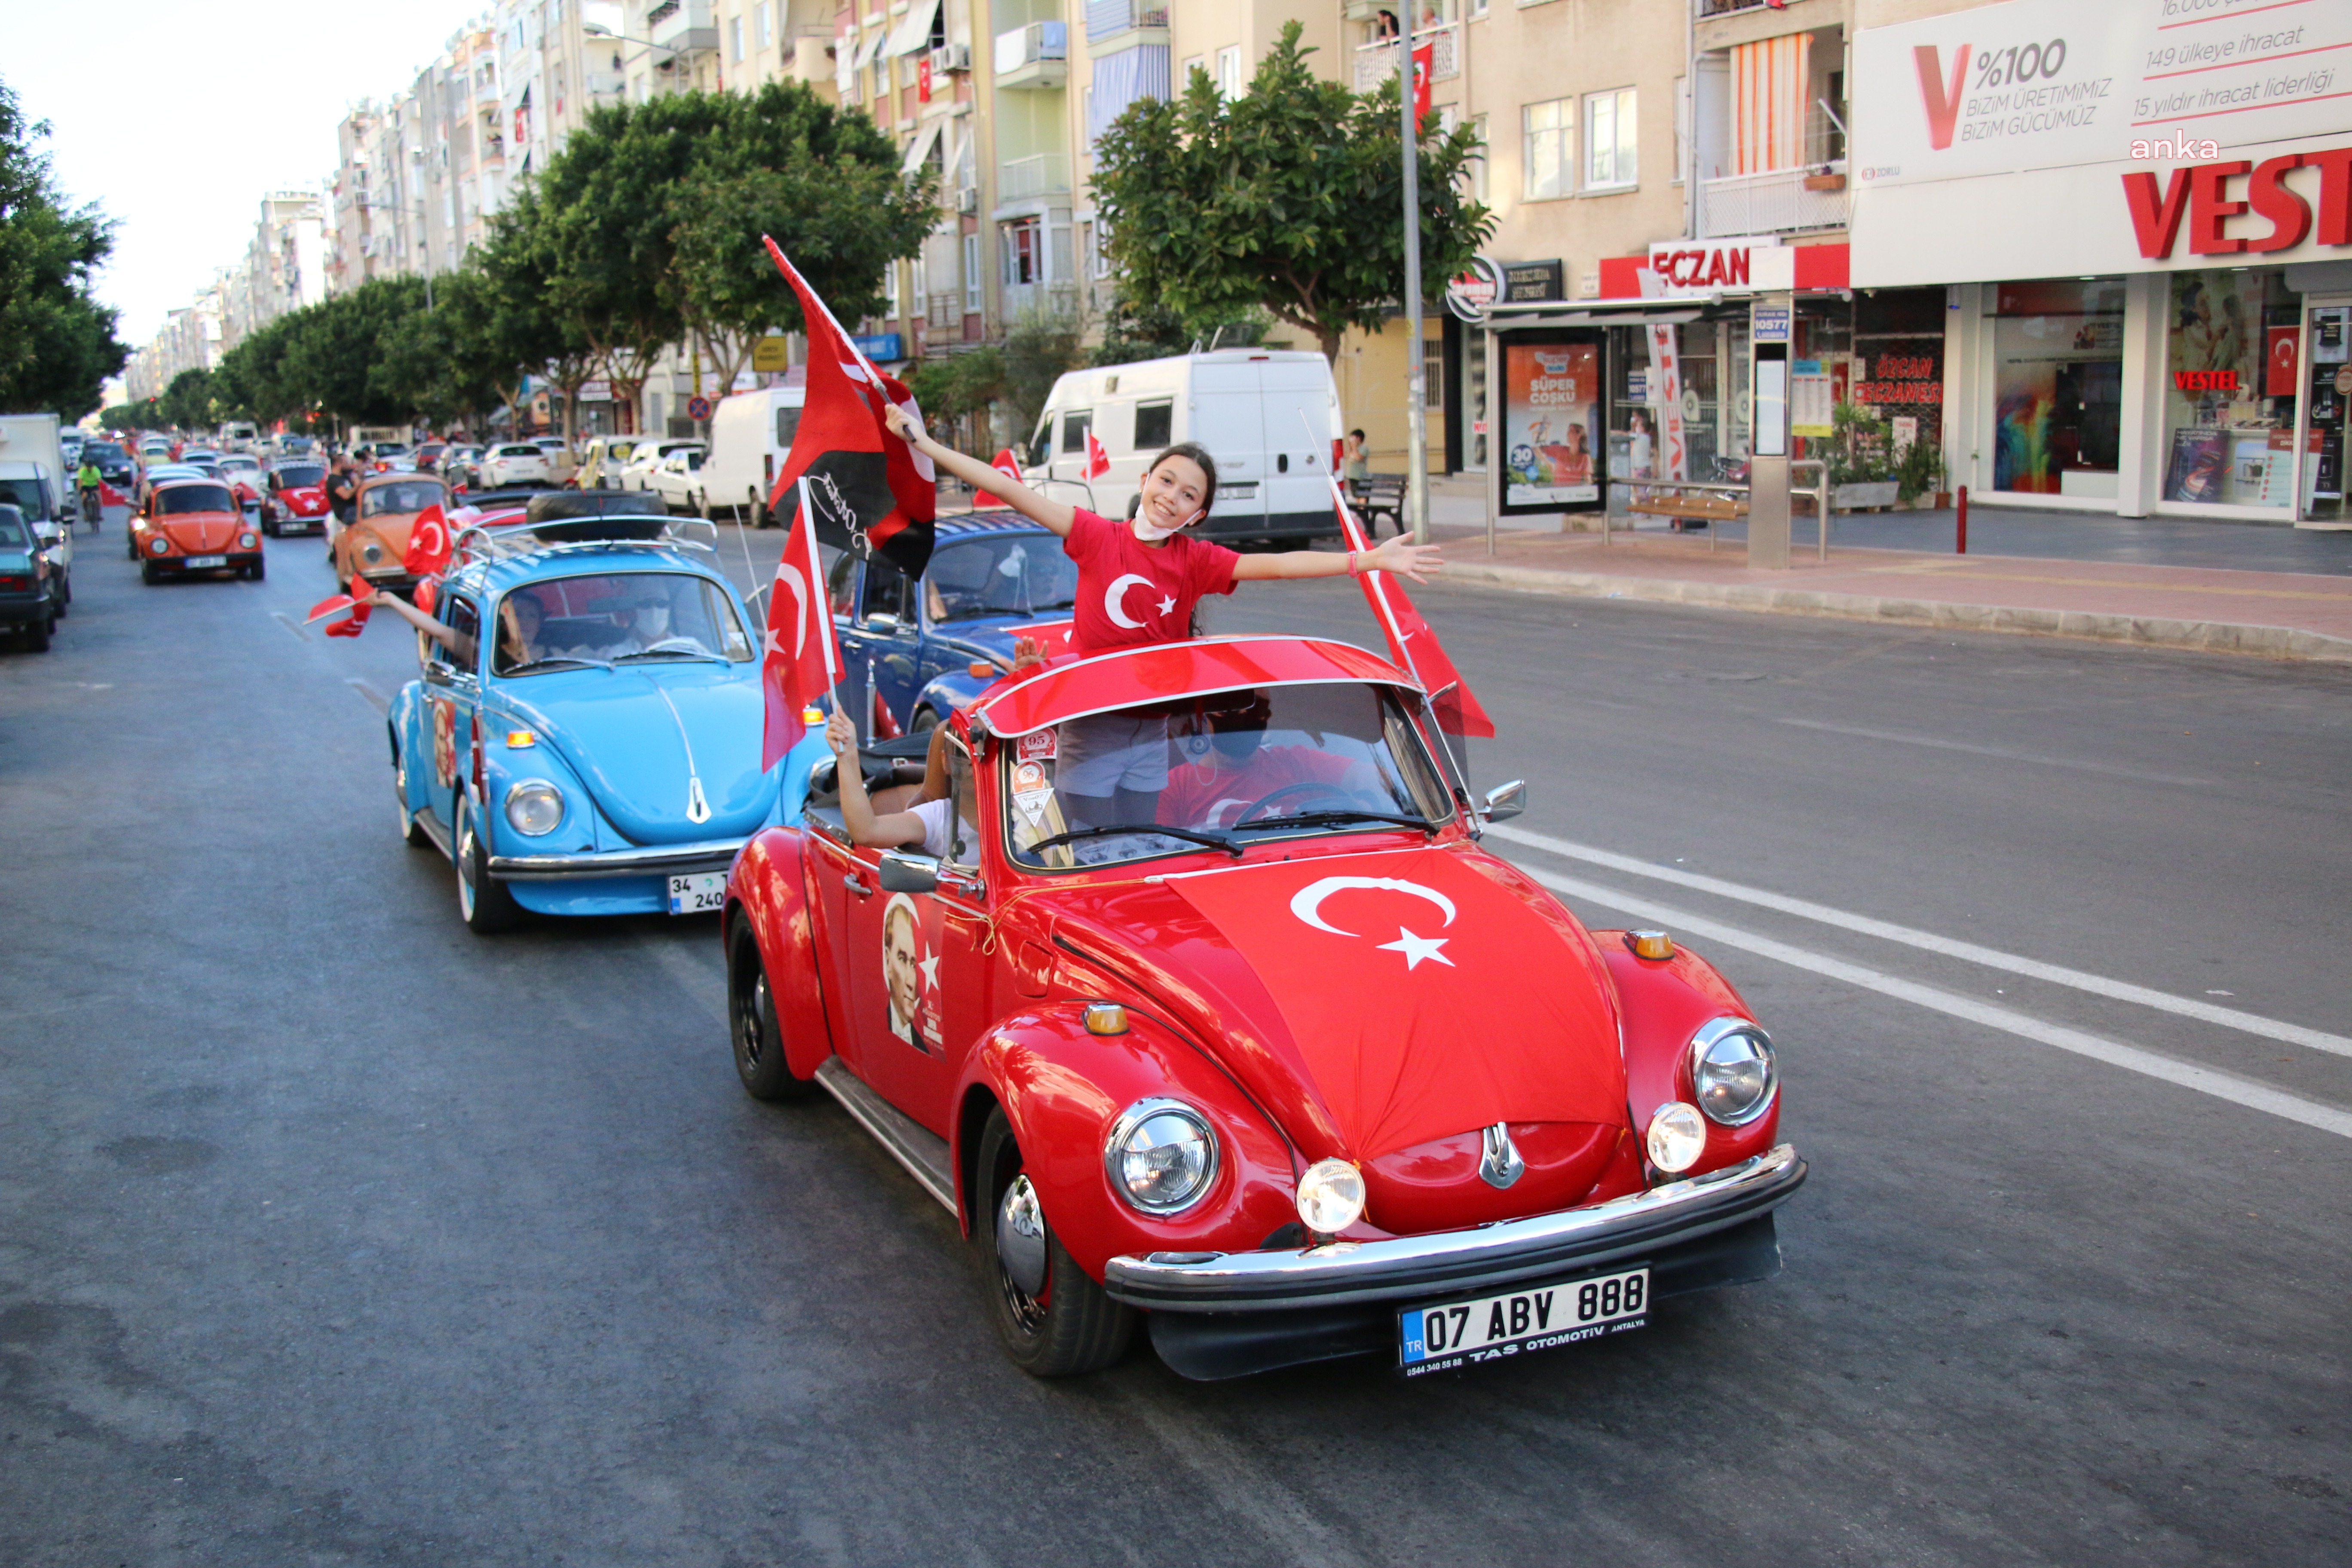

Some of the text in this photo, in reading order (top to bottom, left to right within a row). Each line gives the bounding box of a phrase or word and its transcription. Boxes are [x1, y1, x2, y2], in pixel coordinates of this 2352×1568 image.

[2147, 25, 2304, 69] 149 ülkeye ihracat
[1975, 38, 2066, 89] %100
[2134, 68, 2336, 118] 15 yıldır ihracat liderliği
[2008, 105, 2097, 135] GÜCÜMÜZ
[2121, 147, 2352, 259] VEST
[1755, 319, 1788, 330] 10577
[1876, 354, 1934, 378] ÖZCAN
[1530, 375, 1575, 392] SÜPER
[2173, 370, 2243, 390] VESTEL
[1530, 392, 1576, 404] COŞKU
[1513, 447, 1532, 462] 30
[1028, 735, 1045, 746] 95
[673, 878, 691, 893] 34
[695, 892, 723, 908] 240
[1426, 1274, 1644, 1352] 07 ABV 888
[1611, 1319, 1645, 1332] ANTALYA
[1406, 1339, 1422, 1354] TR
[1407, 1358, 1462, 1376] 0544 340 55 88
